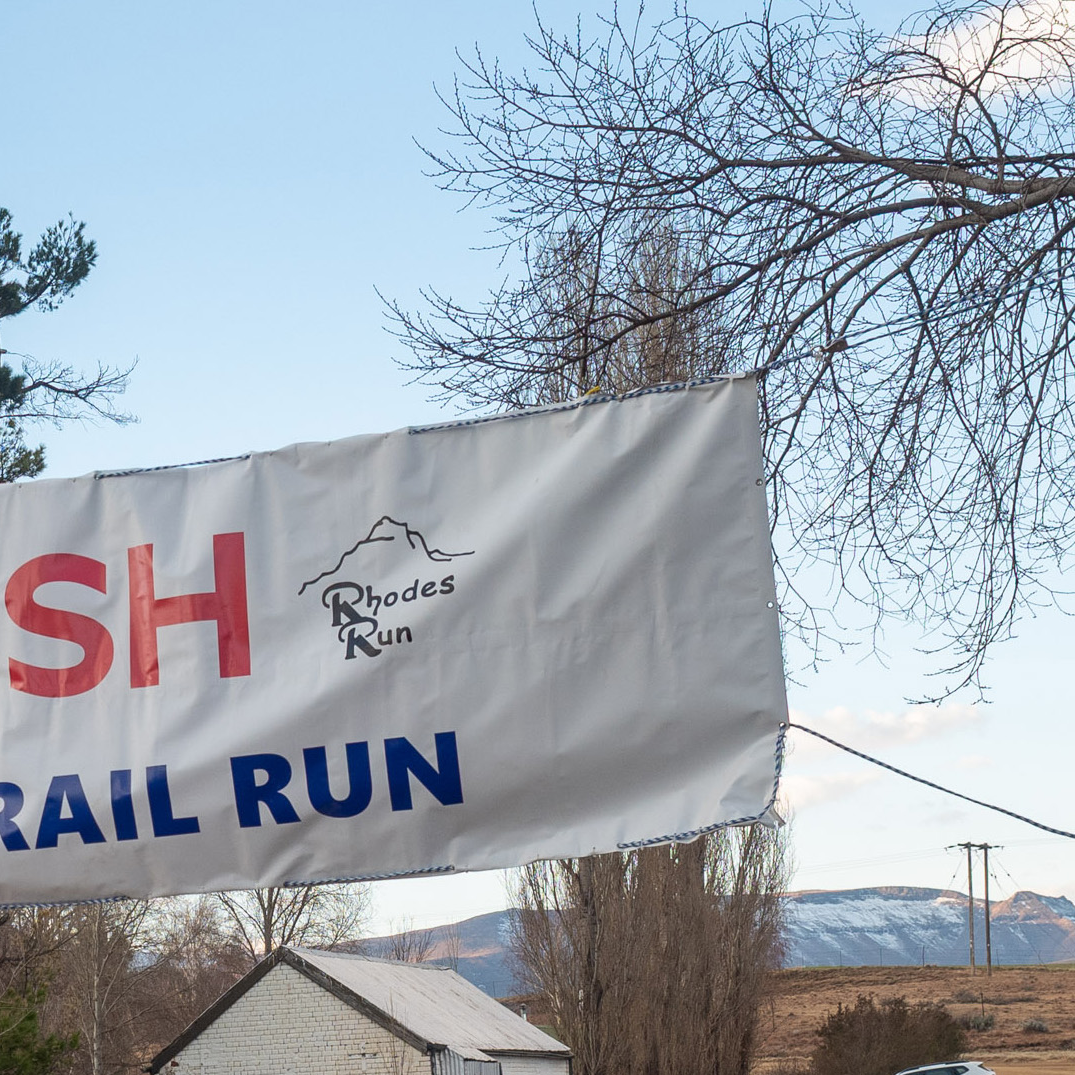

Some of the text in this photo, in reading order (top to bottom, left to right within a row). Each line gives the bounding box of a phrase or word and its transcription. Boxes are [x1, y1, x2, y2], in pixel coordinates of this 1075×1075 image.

[322, 574, 455, 627] Rhodes
[337, 616, 412, 660] Run
[230, 731, 464, 828] RUN
